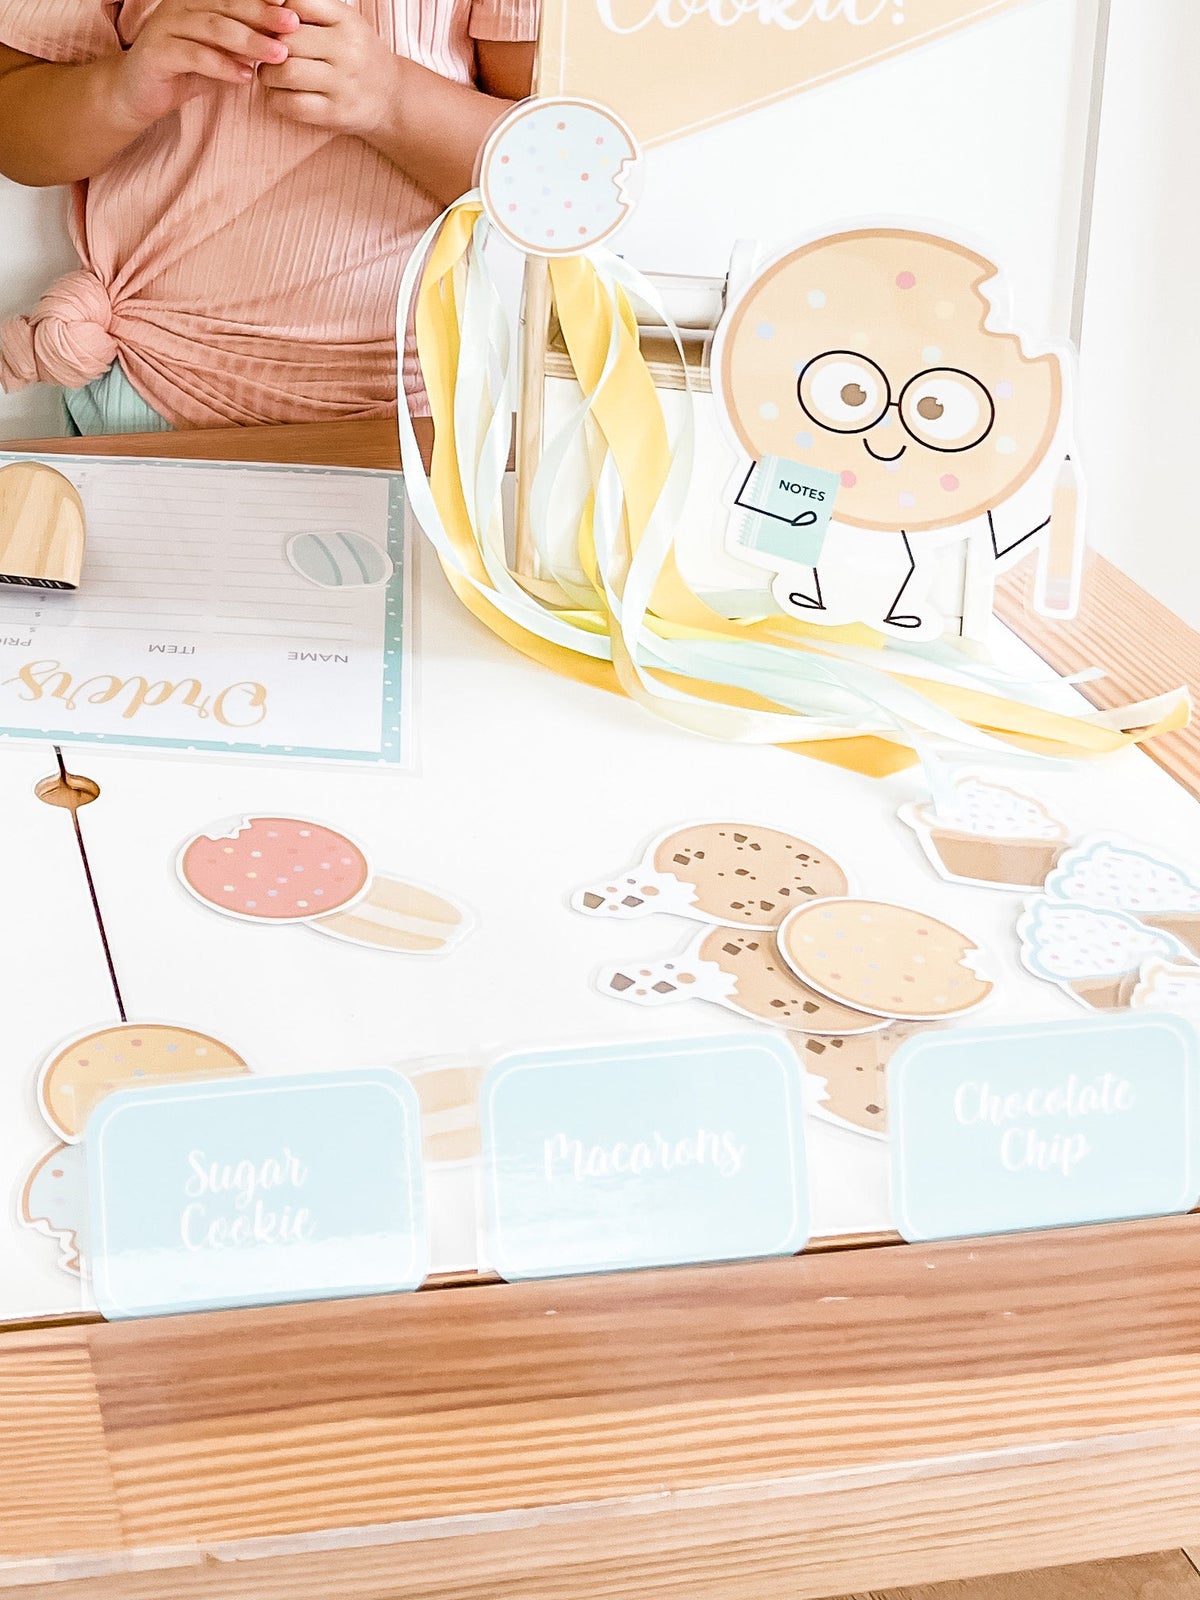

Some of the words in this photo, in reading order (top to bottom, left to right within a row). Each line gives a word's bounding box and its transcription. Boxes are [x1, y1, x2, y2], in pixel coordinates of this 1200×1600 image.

[778, 479, 826, 503] NOTES
[148, 643, 196, 656] ITEM
[287, 650, 349, 664] NAME
[1, 660, 268, 728] Orders
[953, 1072, 1136, 1127] Chocolate
[542, 1127, 746, 1183] Macarons
[998, 1125, 1090, 1177] Chip
[184, 1147, 310, 1216] Sugar
[180, 1204, 318, 1252] Cookie
